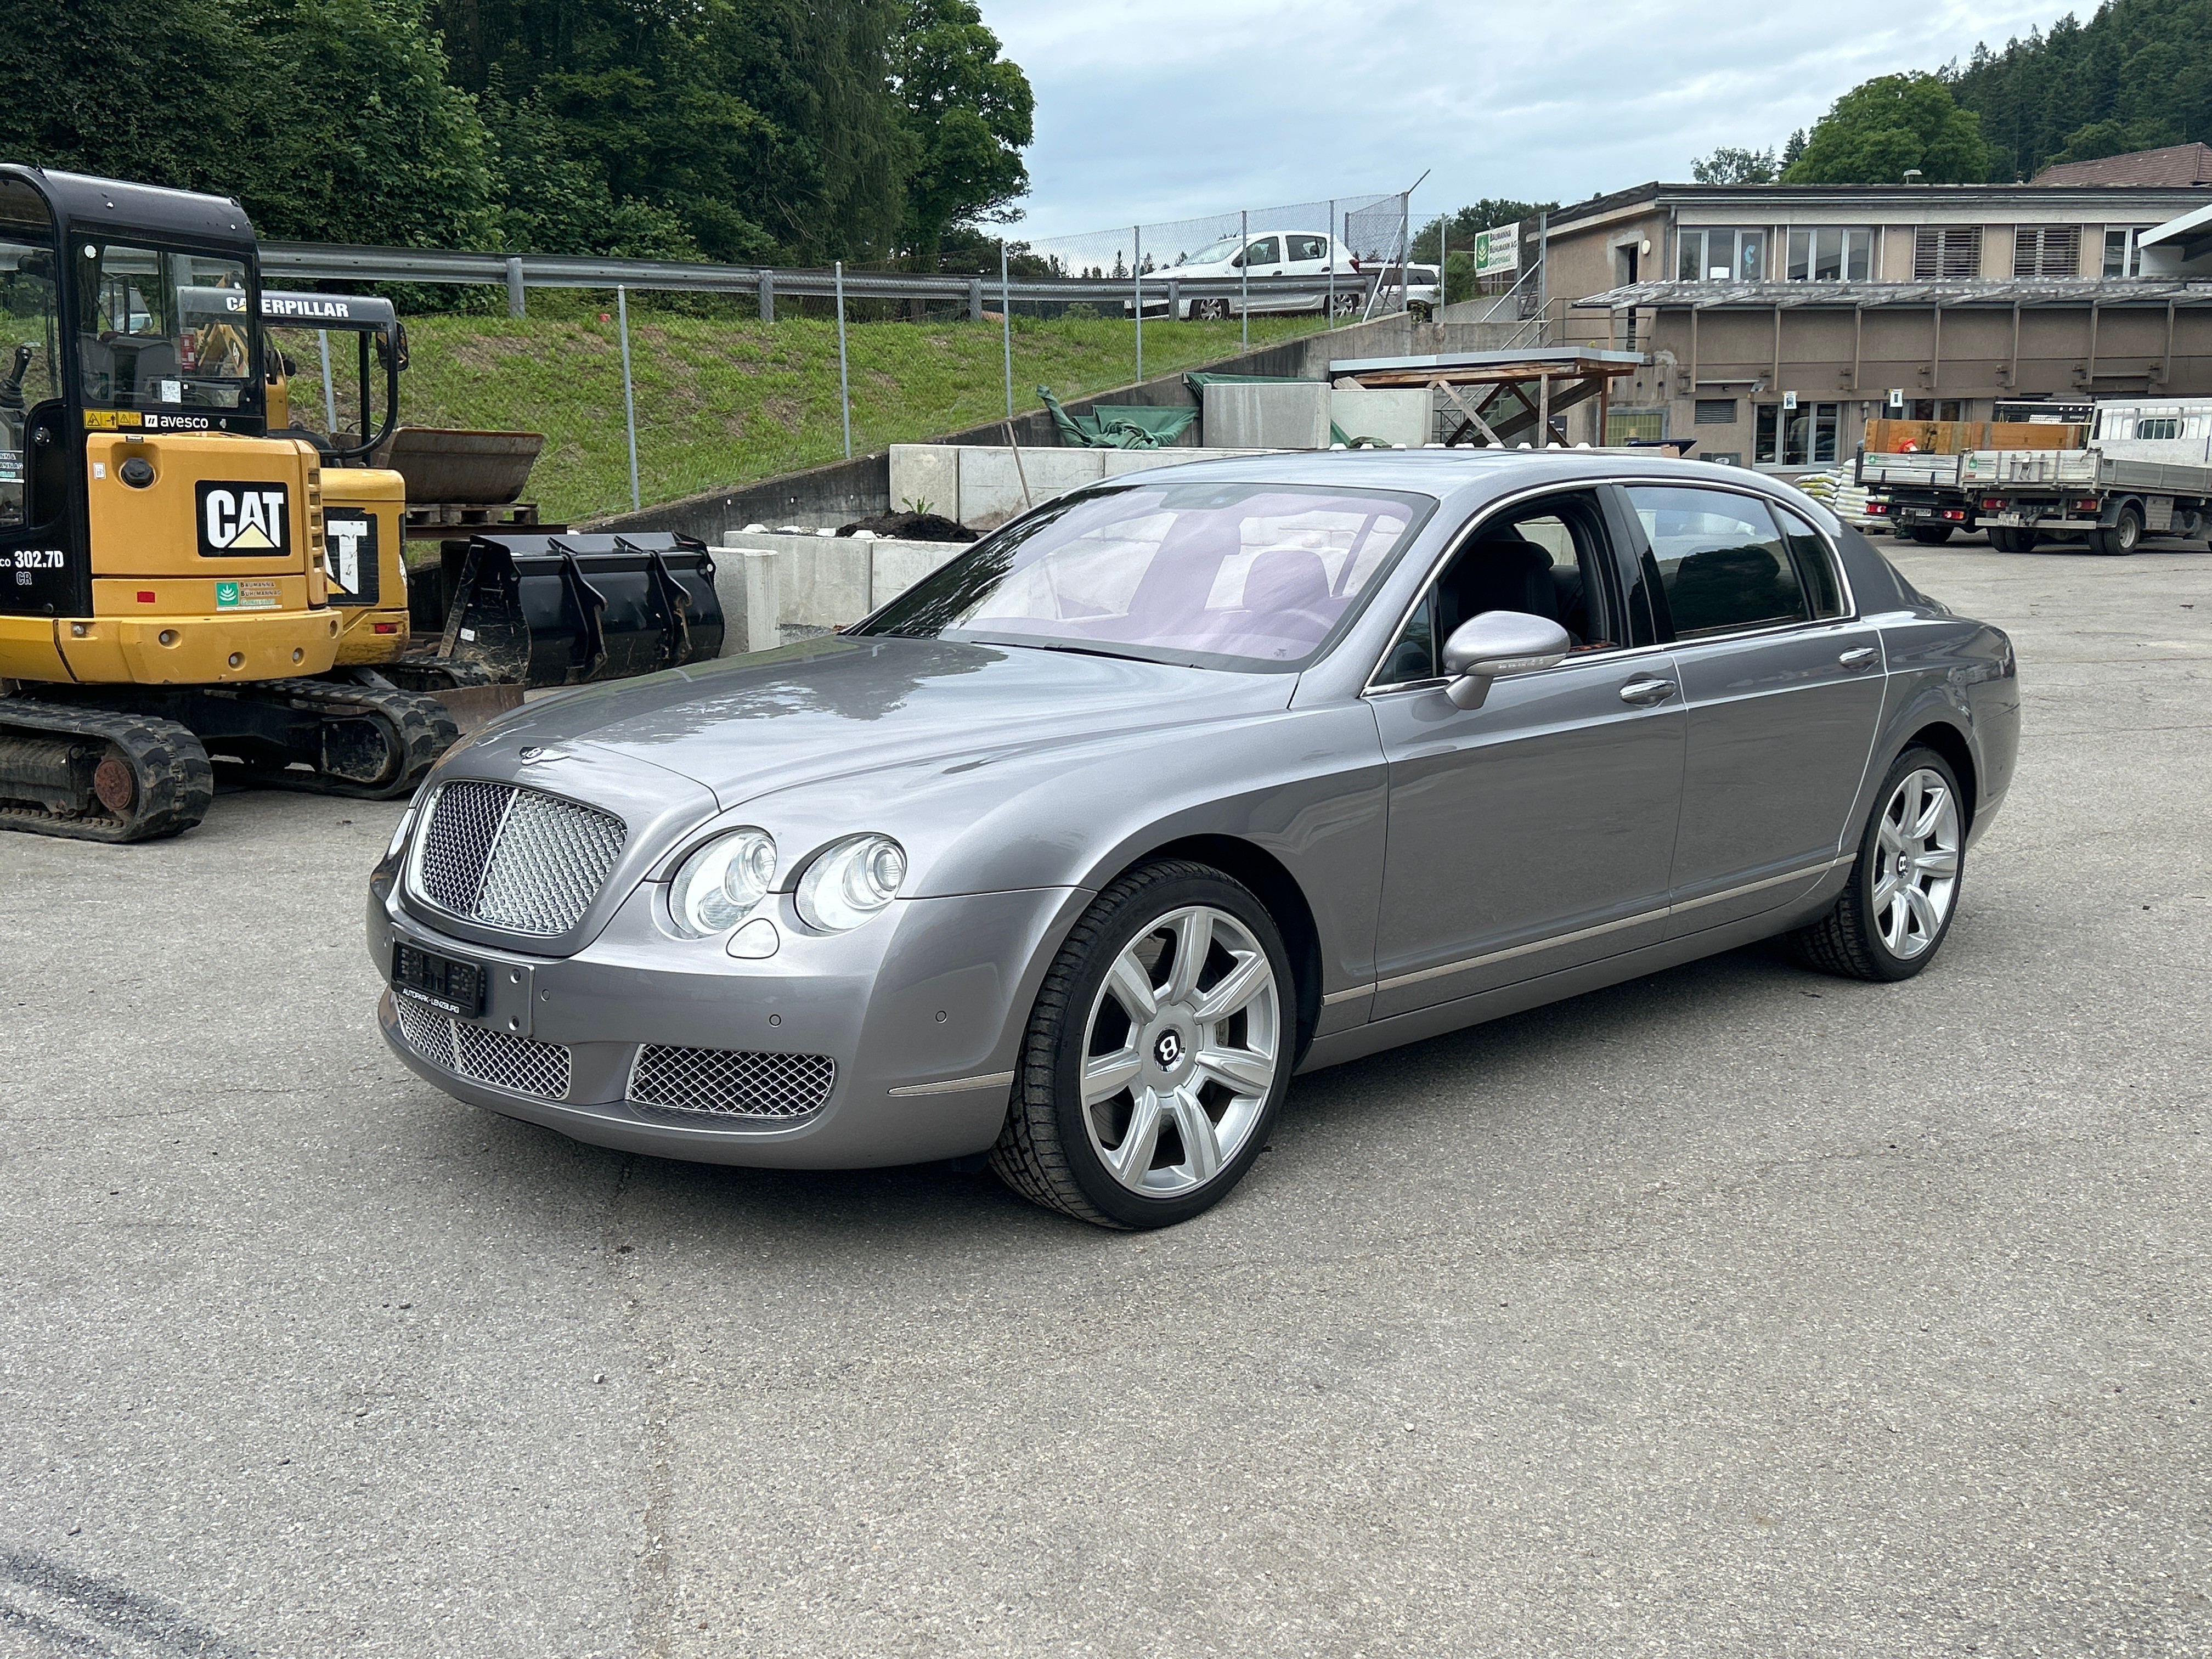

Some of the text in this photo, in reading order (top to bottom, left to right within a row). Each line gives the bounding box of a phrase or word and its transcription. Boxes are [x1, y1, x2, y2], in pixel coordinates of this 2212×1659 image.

[226, 297, 349, 317] CAERPILLAR
[160, 416, 208, 428] avesco
[206, 489, 284, 548] CAT
[14, 550, 64, 568] 302.7D
[16, 571, 32, 585] CR
